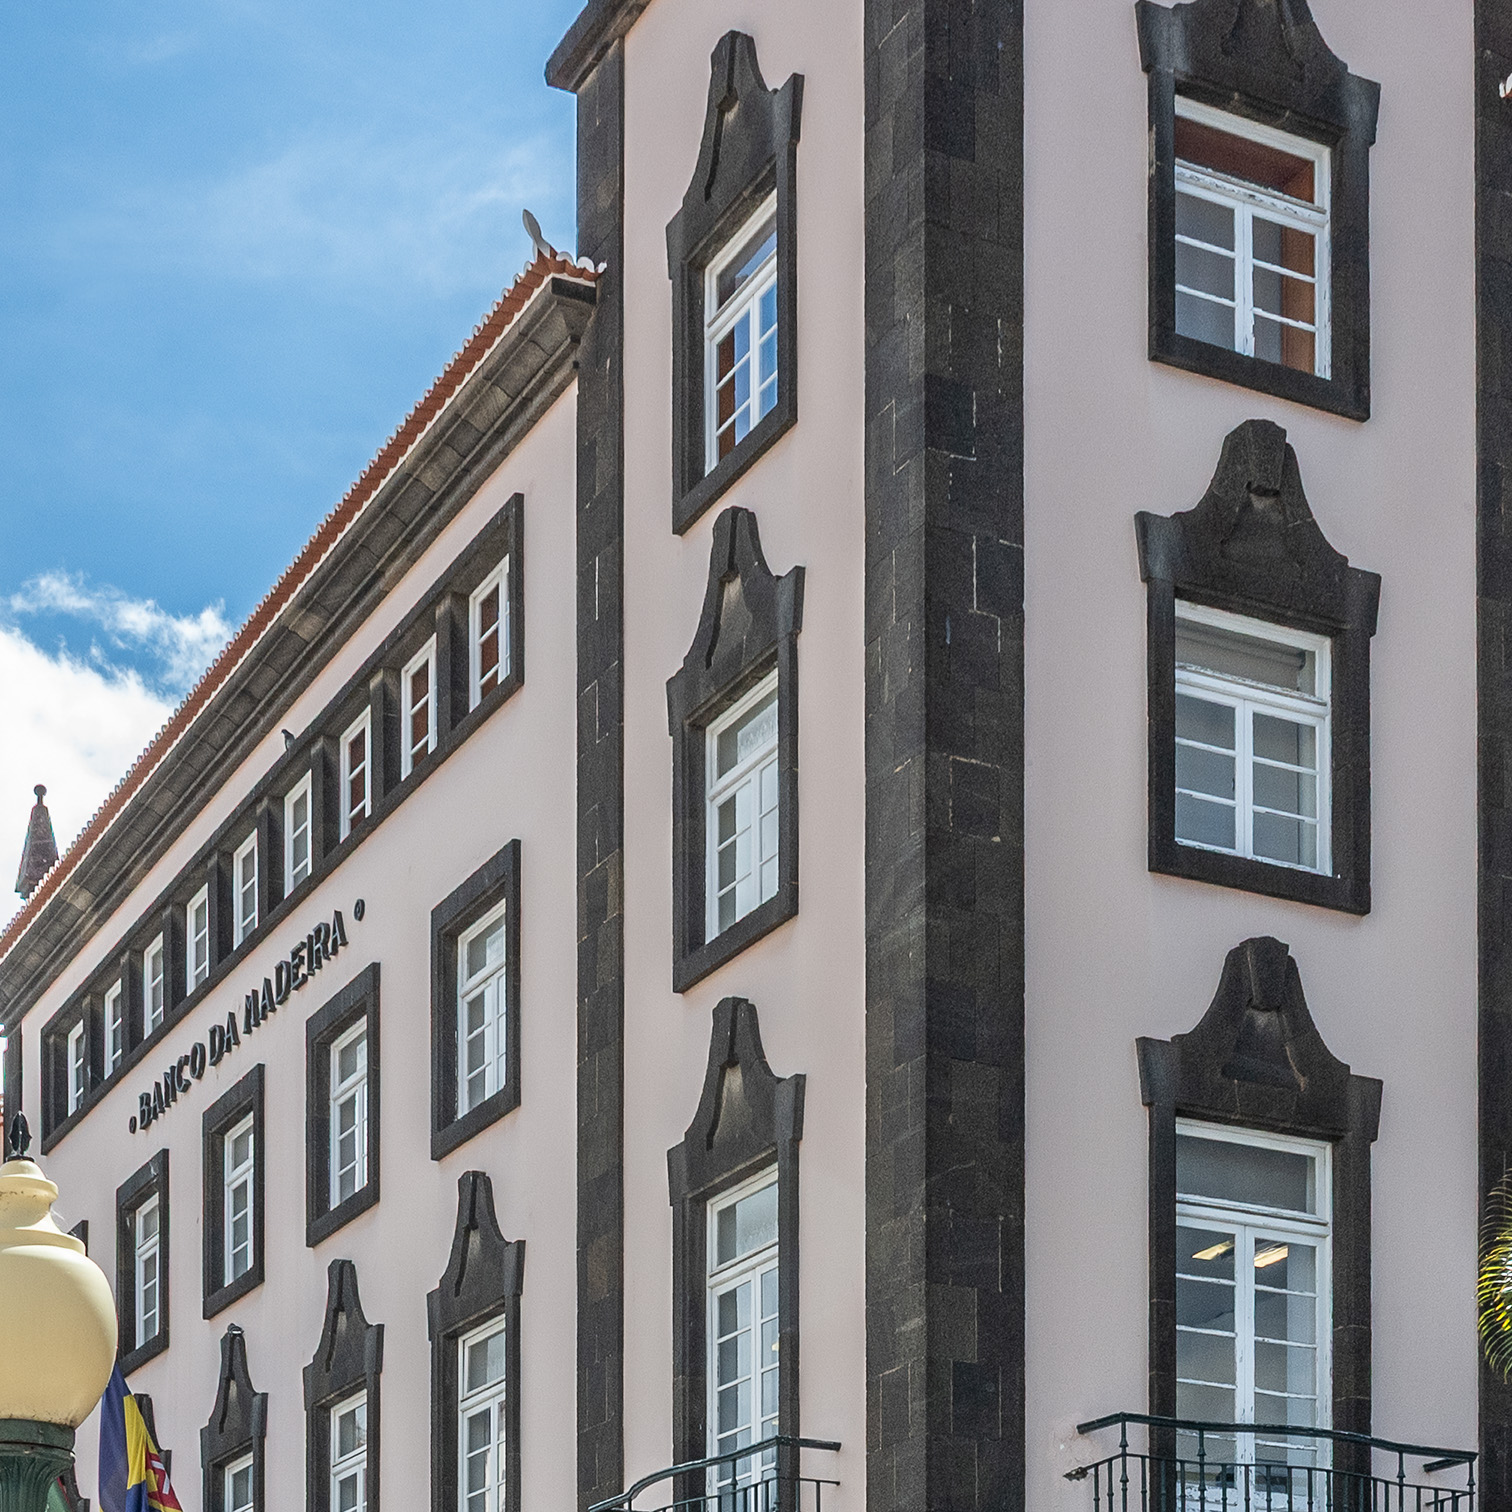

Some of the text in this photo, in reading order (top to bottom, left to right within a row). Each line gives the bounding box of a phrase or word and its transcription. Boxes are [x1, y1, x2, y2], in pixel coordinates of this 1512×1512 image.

[138, 909, 349, 1130] BANCO DA MADEIRA
